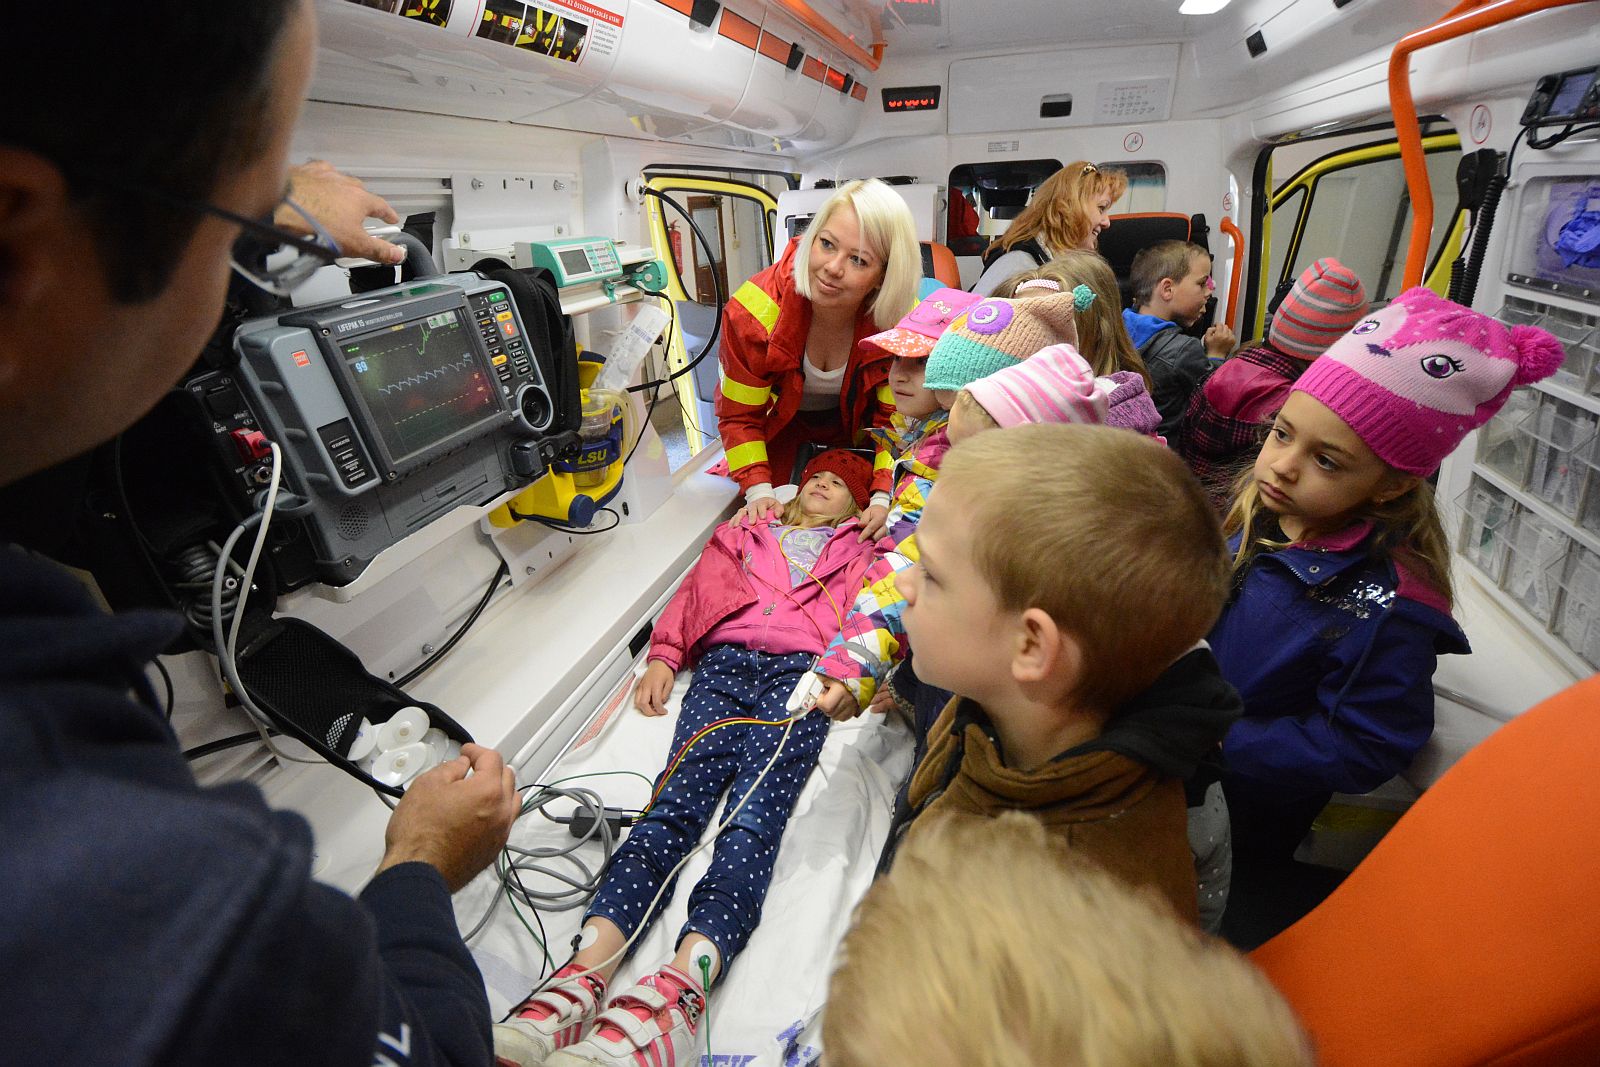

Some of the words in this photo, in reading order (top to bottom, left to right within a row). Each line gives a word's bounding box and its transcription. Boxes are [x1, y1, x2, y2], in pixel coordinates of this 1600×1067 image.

[573, 1, 609, 20] ÖSSZEKAPCSOLÁS
[337, 320, 360, 333] LIFEPAK
[359, 319, 366, 328] 15
[355, 361, 368, 374] 99
[577, 448, 607, 465] LSU
